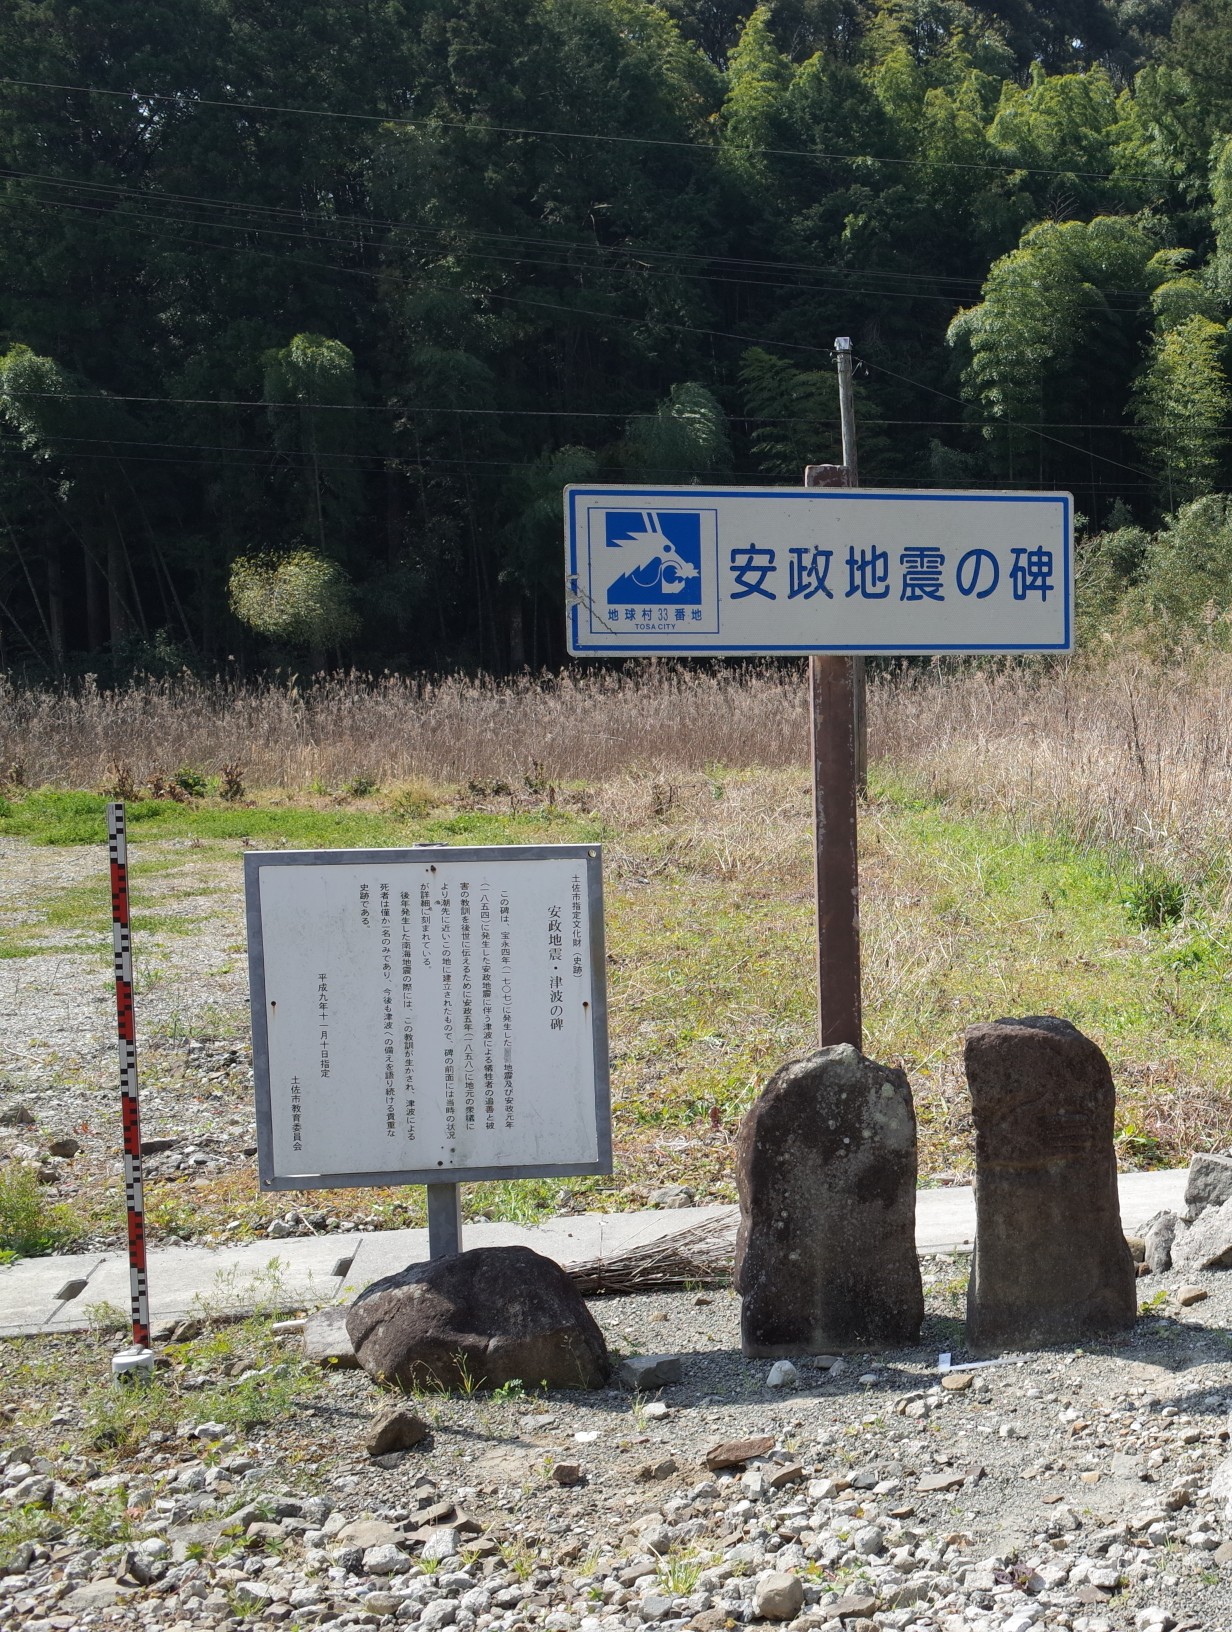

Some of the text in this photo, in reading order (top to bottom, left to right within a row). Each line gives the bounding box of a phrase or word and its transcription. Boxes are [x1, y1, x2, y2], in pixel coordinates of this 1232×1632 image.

[729, 543, 1055, 603] 安政地震の碑
[608, 608, 702, 621] 地球村33番地
[360, 883, 370, 928] 史跡である。
[547, 905, 564, 1031] 安政地震・津波の碑
[318, 973, 330, 1078] 平成九年十一月十日指定
[291, 1075, 302, 1151] 土佐市教育委員会
